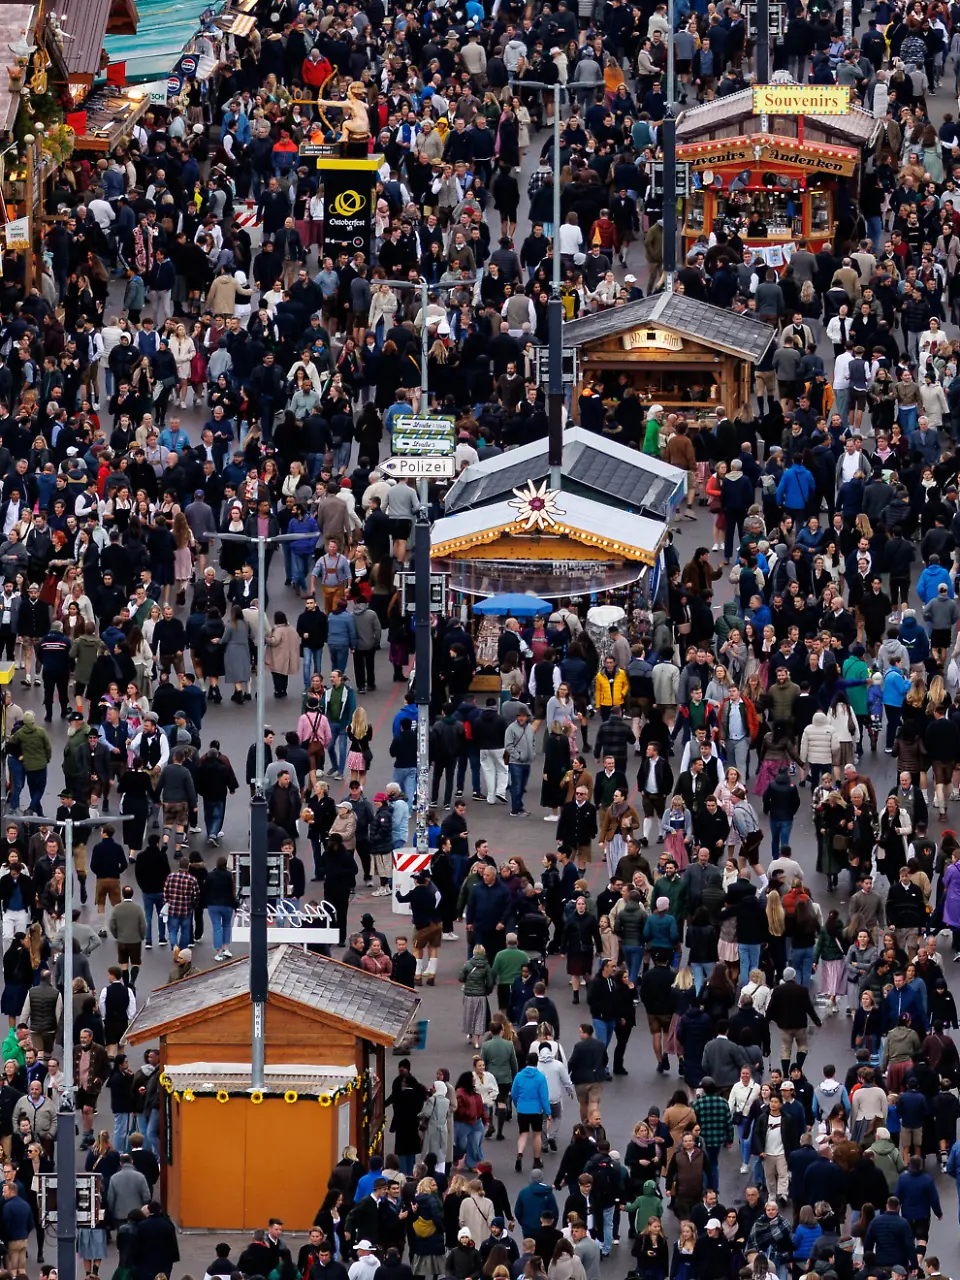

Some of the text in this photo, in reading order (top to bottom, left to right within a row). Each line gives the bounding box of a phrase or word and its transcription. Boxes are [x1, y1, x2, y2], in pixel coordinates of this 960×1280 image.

[764, 92, 839, 107] Souvenirs
[767, 148, 843, 171] Andenken
[328, 218, 366, 227] Oktoberfest
[400, 460, 447, 473] Polizei
